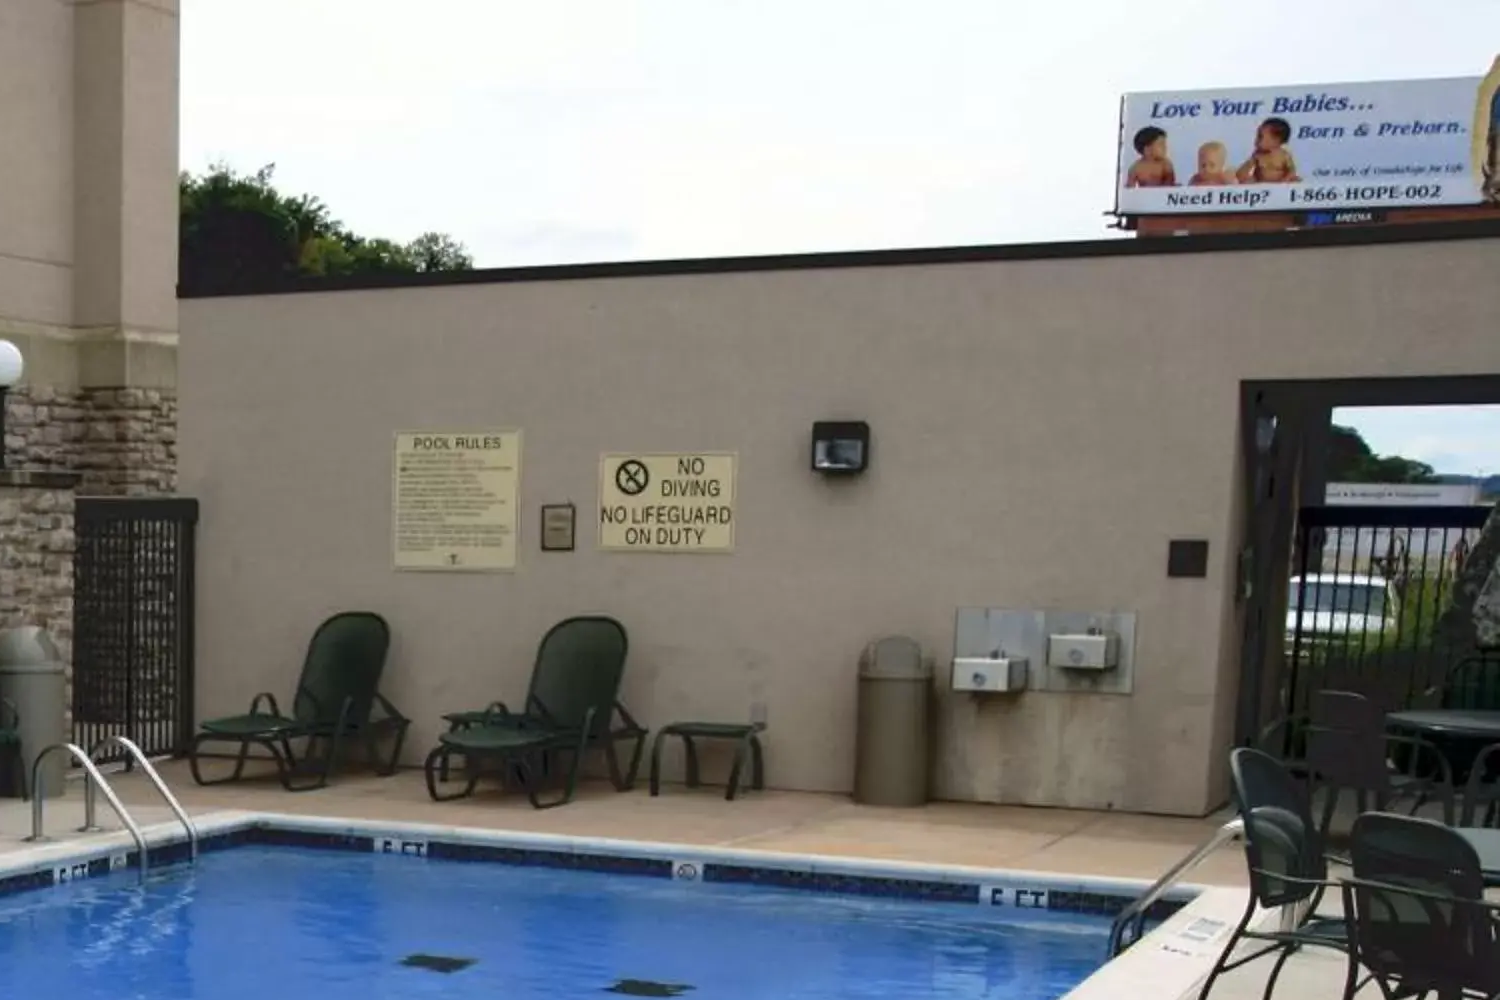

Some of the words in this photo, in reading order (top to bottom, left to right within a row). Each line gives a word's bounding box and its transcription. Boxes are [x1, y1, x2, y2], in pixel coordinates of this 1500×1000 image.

[1151, 101, 1202, 119] Love
[1212, 99, 1263, 117] Your
[1271, 93, 1374, 113] Babies...
[1297, 125, 1345, 139] Born
[1353, 123, 1369, 137] &
[1377, 120, 1467, 136] Preborn.
[1167, 191, 1213, 206] Need
[1220, 189, 1270, 207] Help?
[413, 436, 450, 450] POOL
[455, 436, 501, 450] RULES
[678, 457, 706, 476] NO
[661, 479, 721, 497] DIVING
[601, 505, 627, 525] NO
[631, 504, 732, 525] LIFEGUARD
[625, 527, 651, 545] ON
[656, 527, 705, 545] DUTY
